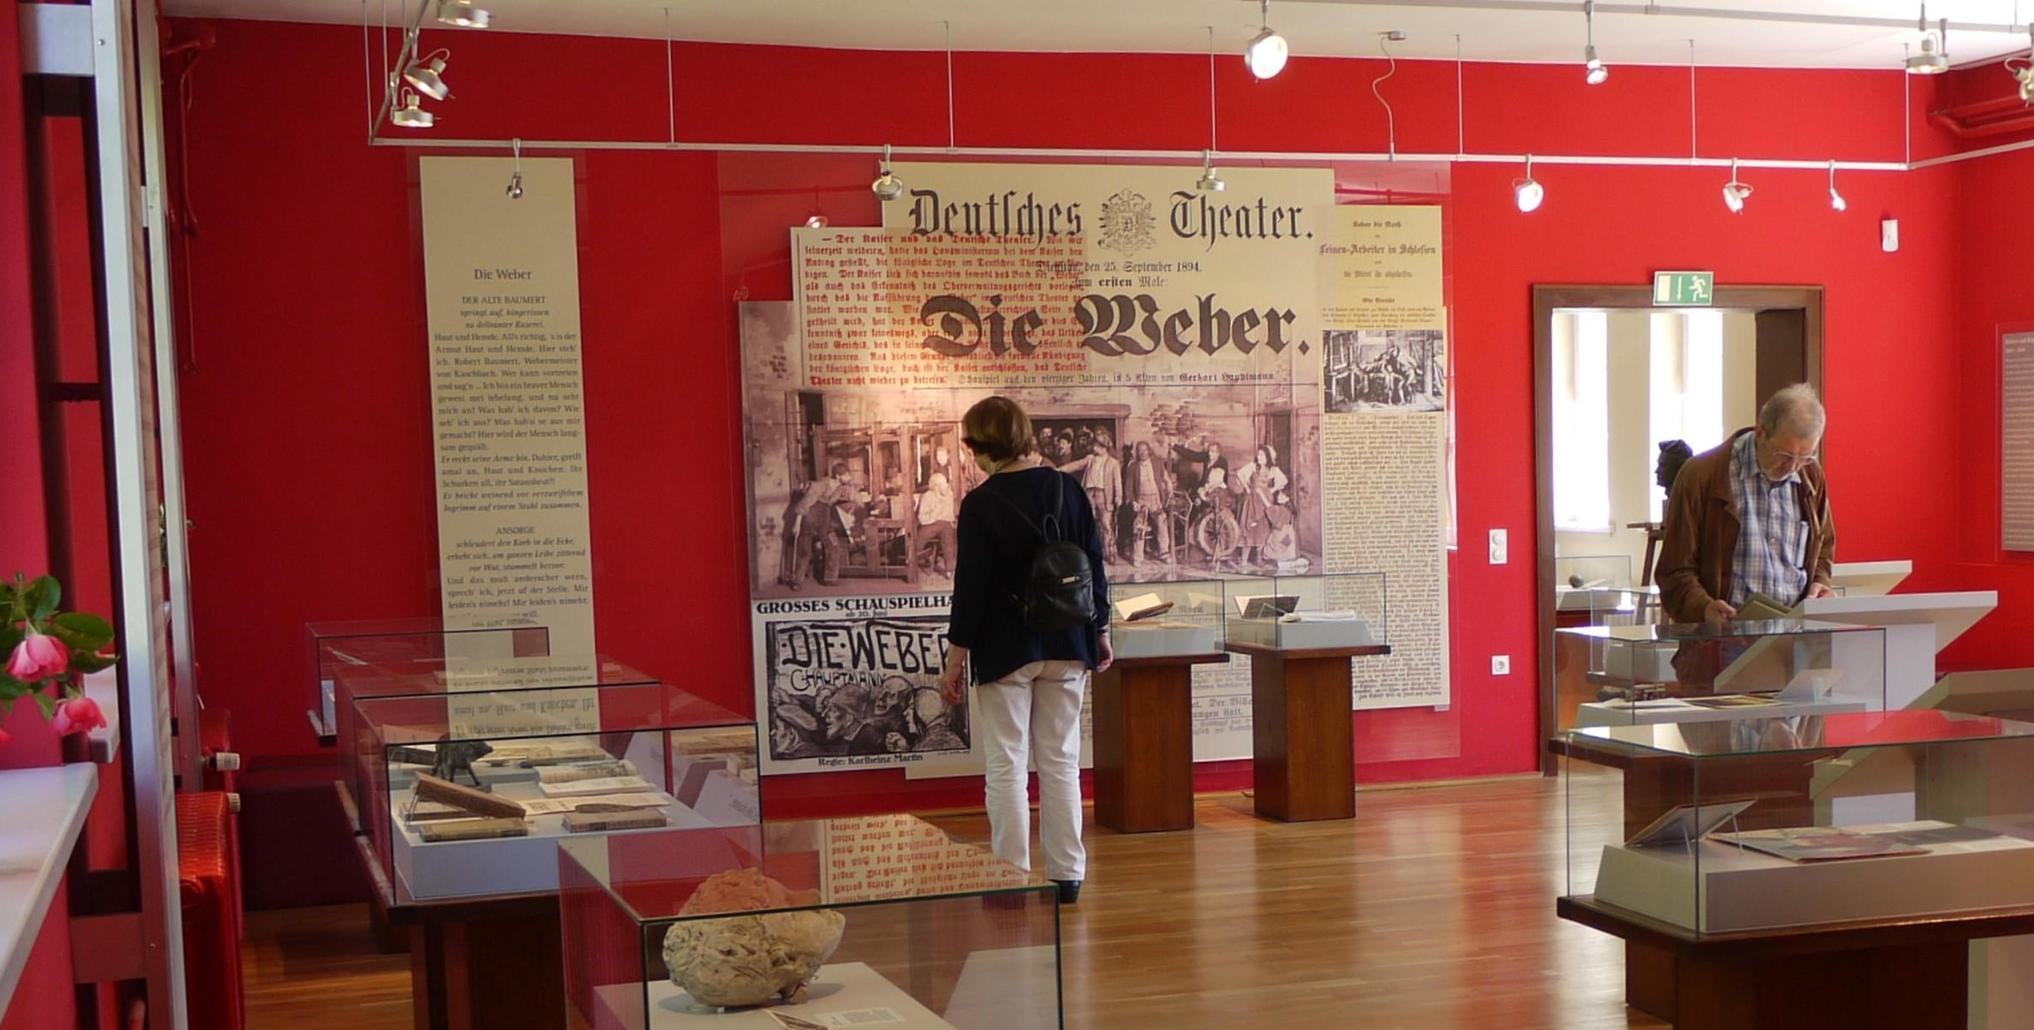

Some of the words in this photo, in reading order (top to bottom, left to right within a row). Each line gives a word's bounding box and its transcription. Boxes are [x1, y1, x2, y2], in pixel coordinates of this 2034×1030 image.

[909, 188, 1083, 250] Deutsches
[1169, 189, 1314, 252] Theater.
[474, 268, 495, 280] Die
[496, 267, 533, 280] Weber
[1084, 261, 1101, 272] den
[1125, 260, 1172, 274] September
[1177, 260, 1202, 272] 1894.
[1098, 277, 1133, 289] ersten
[921, 292, 1043, 357] Die
[1074, 292, 1311, 358] Weber.
[1179, 371, 1219, 383] Gerhart
[496, 526, 535, 534] ANSORGE
[757, 599, 830, 614] GROSSES
[818, 757, 845, 768] Regie:
[847, 755, 892, 767] Karlheinz
[894, 753, 923, 764] Martin
